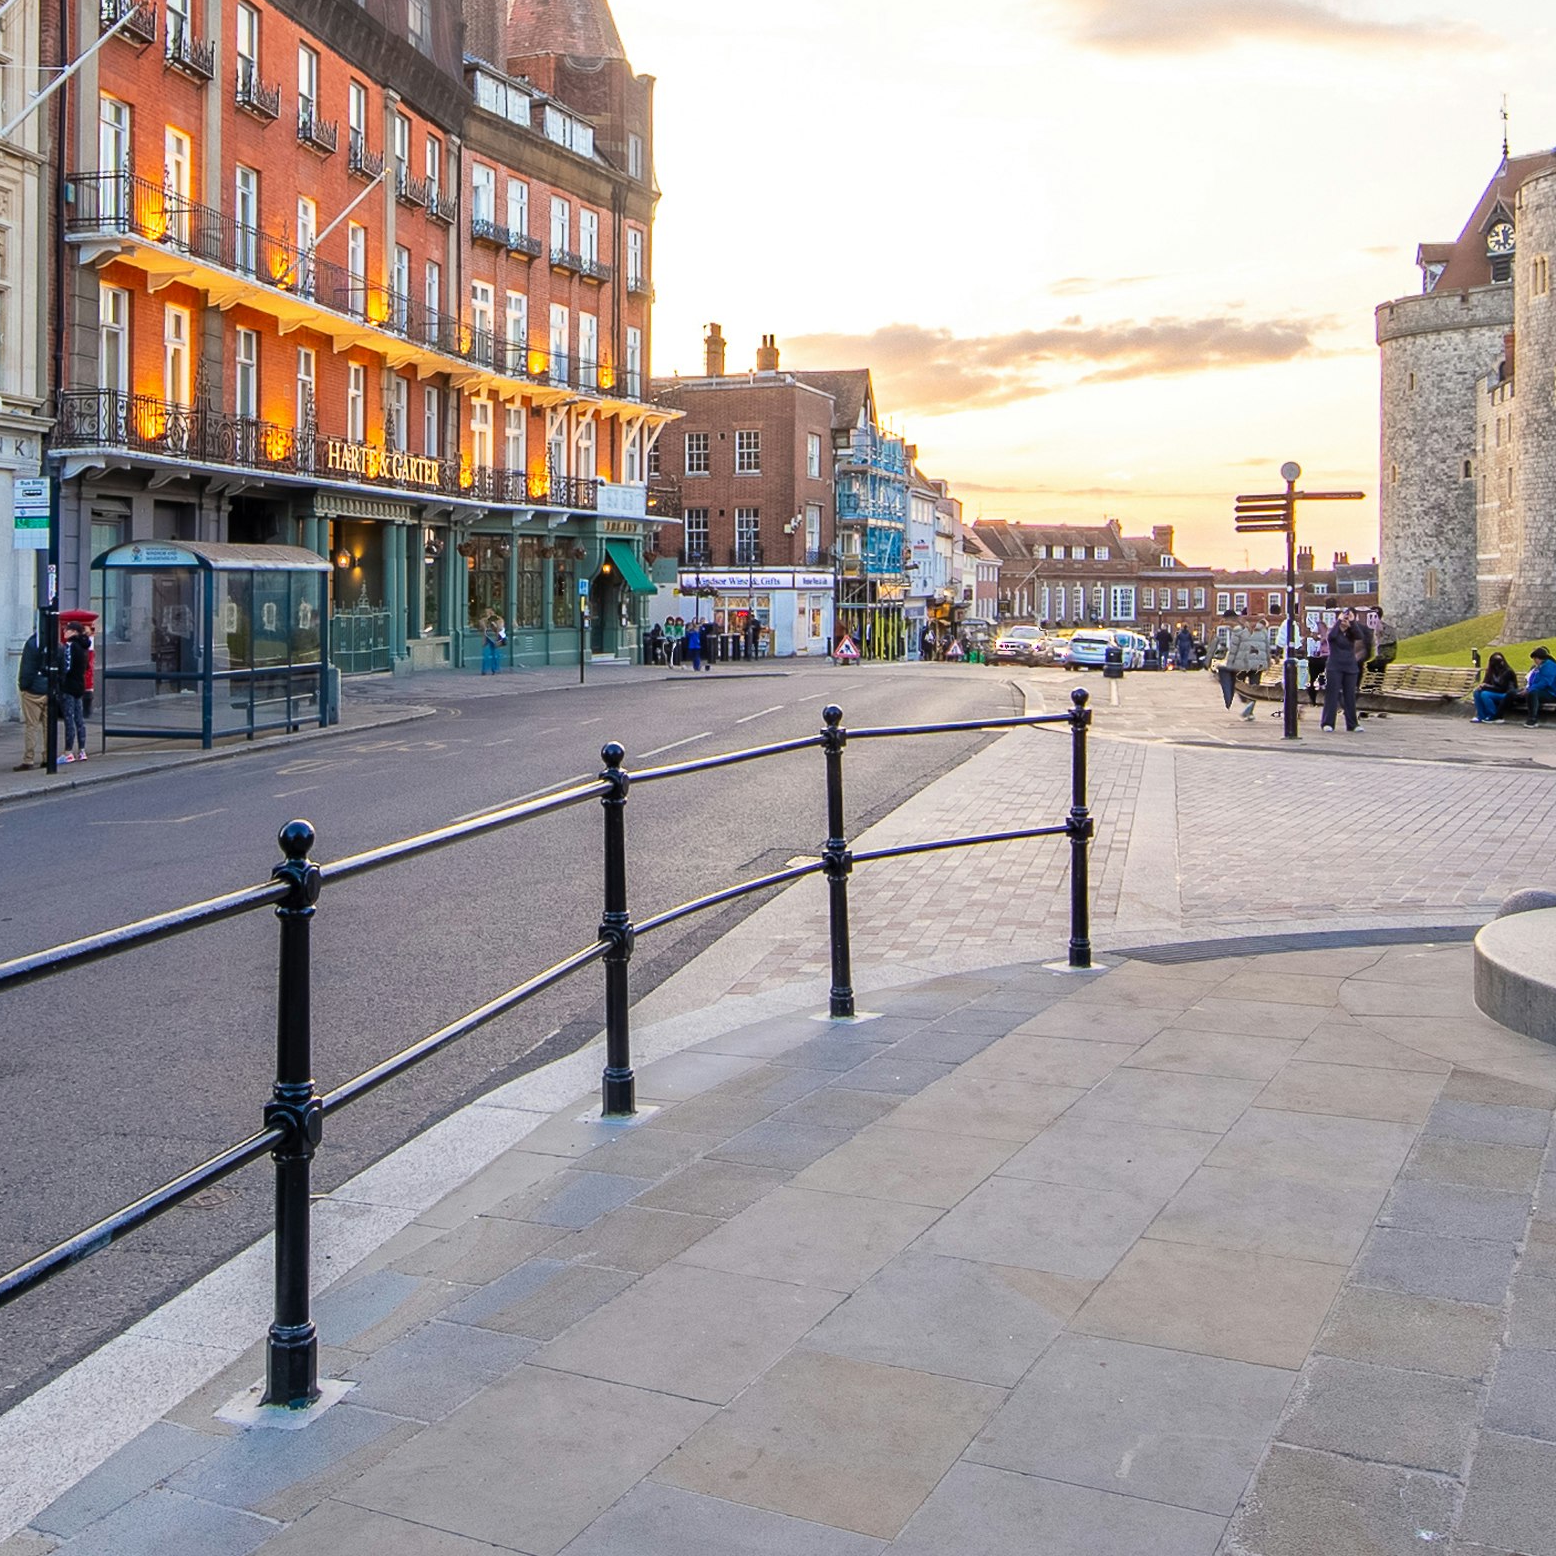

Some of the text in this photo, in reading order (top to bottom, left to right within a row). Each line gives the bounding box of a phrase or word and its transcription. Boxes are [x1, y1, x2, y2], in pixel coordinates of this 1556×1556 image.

[327, 440, 440, 486] HARTE & GARTER
[760, 575, 781, 585] Gifts
